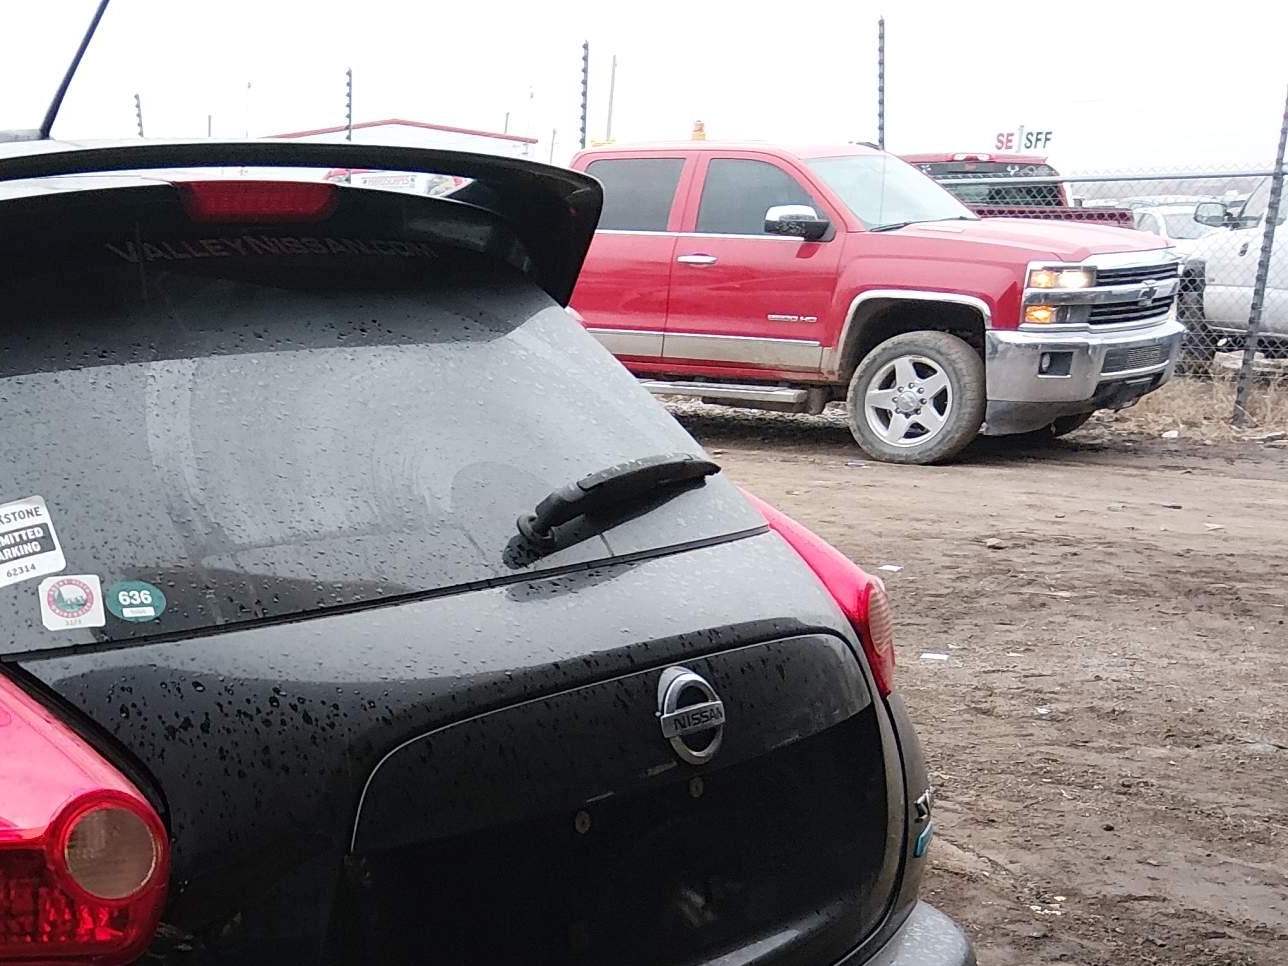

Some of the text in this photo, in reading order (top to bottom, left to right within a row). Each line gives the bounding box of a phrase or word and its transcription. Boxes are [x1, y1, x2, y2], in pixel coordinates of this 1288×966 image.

[6, 563, 36, 577] 62314
[118, 590, 152, 605] 636
[673, 707, 723, 730] NISSAN
